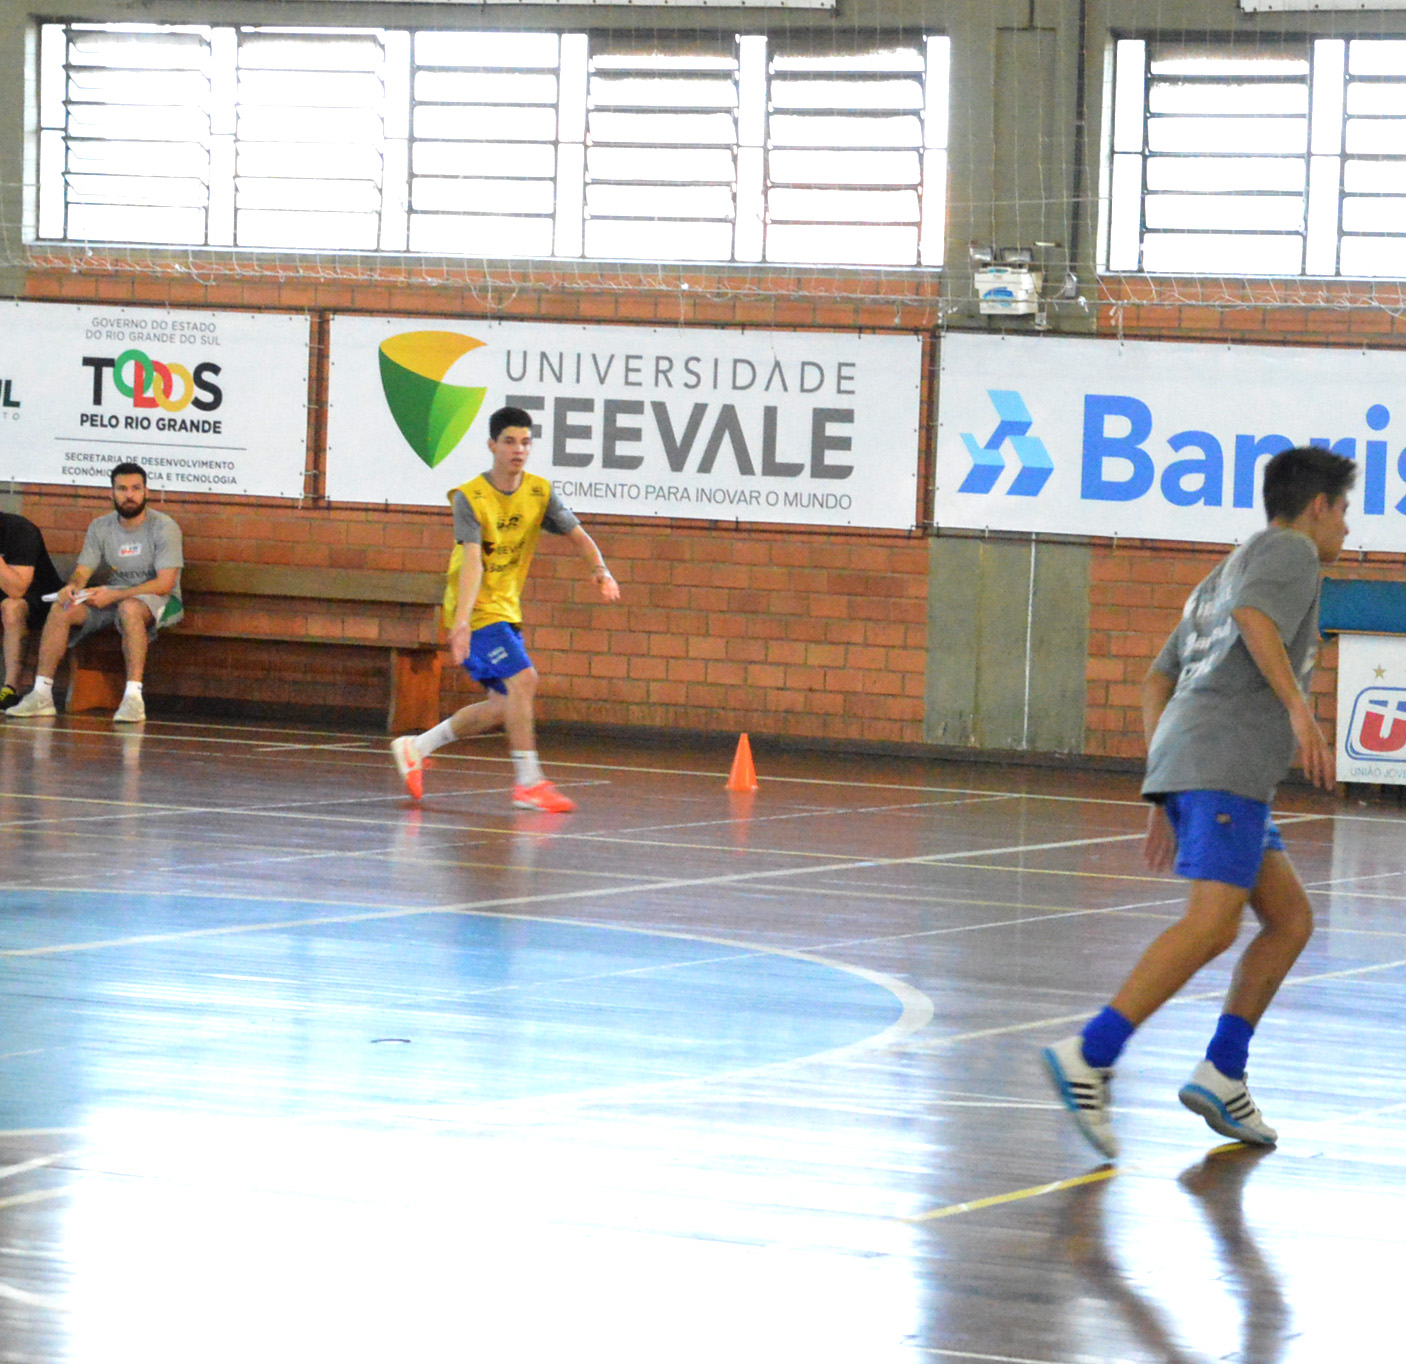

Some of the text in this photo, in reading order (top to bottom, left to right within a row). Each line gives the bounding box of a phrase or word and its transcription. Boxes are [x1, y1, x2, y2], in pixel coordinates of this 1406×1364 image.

[92, 317, 217, 334] GOVERNO DO ESTADO
[85, 329, 221, 346] DO RIO GRANDE DO SUL
[82, 349, 223, 412] TODOS
[505, 349, 856, 395] UNIVERSIDADE
[0, 379, 21, 408] L
[80, 413, 223, 434] PELO RIO GRANDE
[64, 452, 236, 471] SECRETARIA DE DESENVOLVIMENTO
[61, 464, 113, 478] ECONÔMIC
[166, 472, 172, 482] E
[175, 472, 238, 485] TECNOLOGIA
[552, 479, 853, 511] ECIMENTO PARA INOVAR O MUNDO
[1350, 767, 1382, 778] UNIÃO
